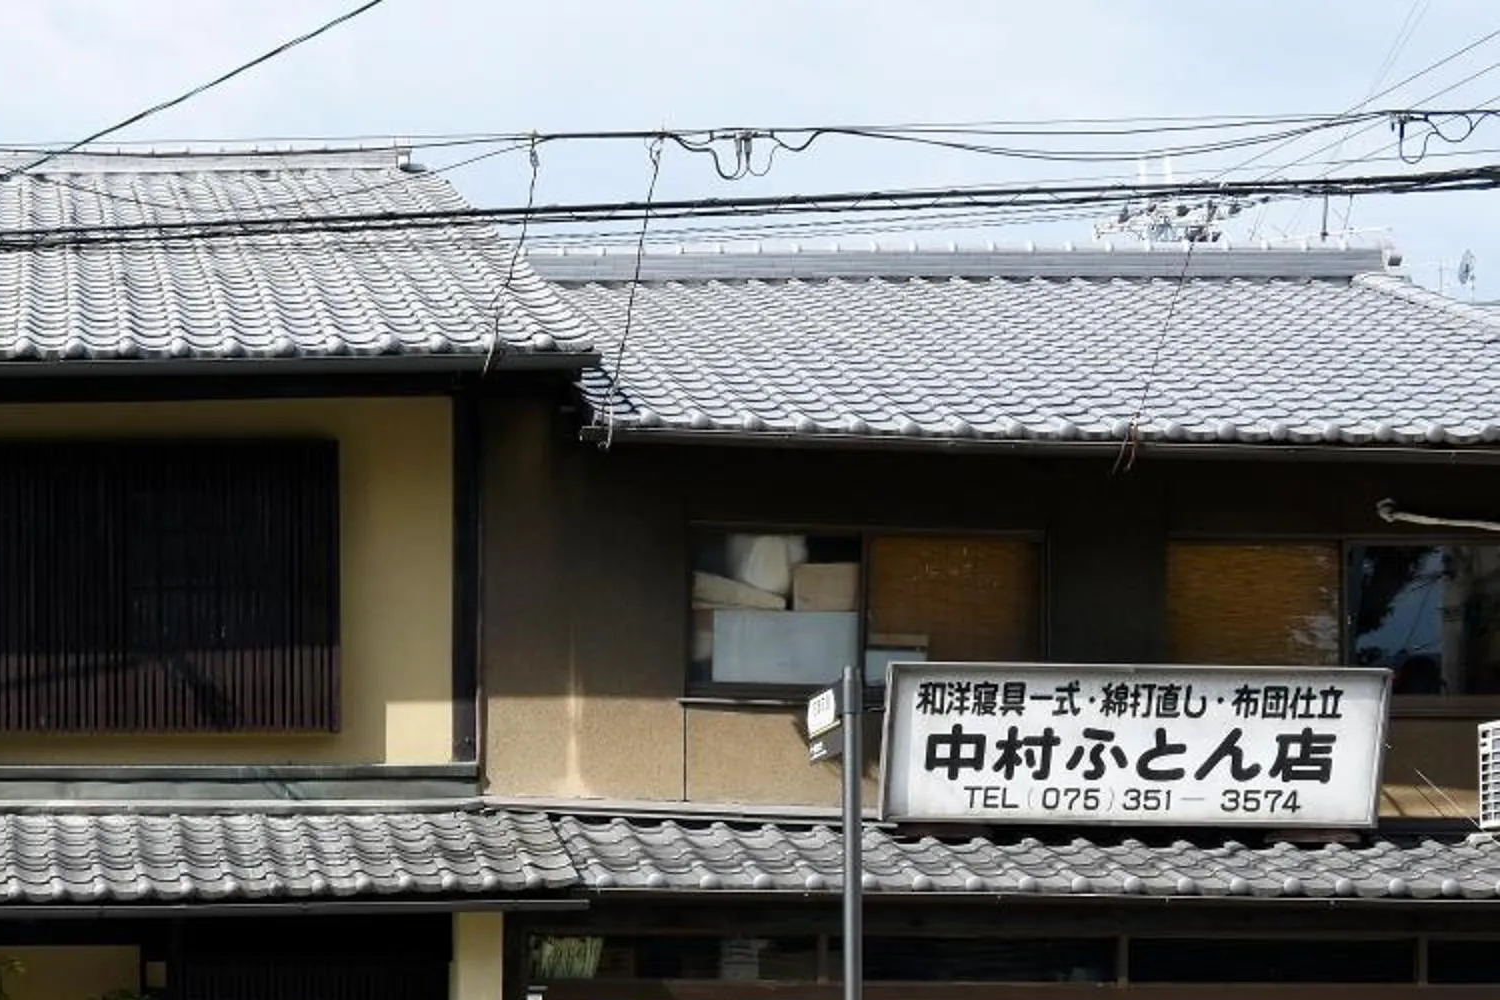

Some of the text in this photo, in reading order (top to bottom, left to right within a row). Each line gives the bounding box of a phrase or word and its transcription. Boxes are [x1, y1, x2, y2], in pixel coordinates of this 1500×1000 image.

[925, 723, 1337, 784] 中村ふとん店
